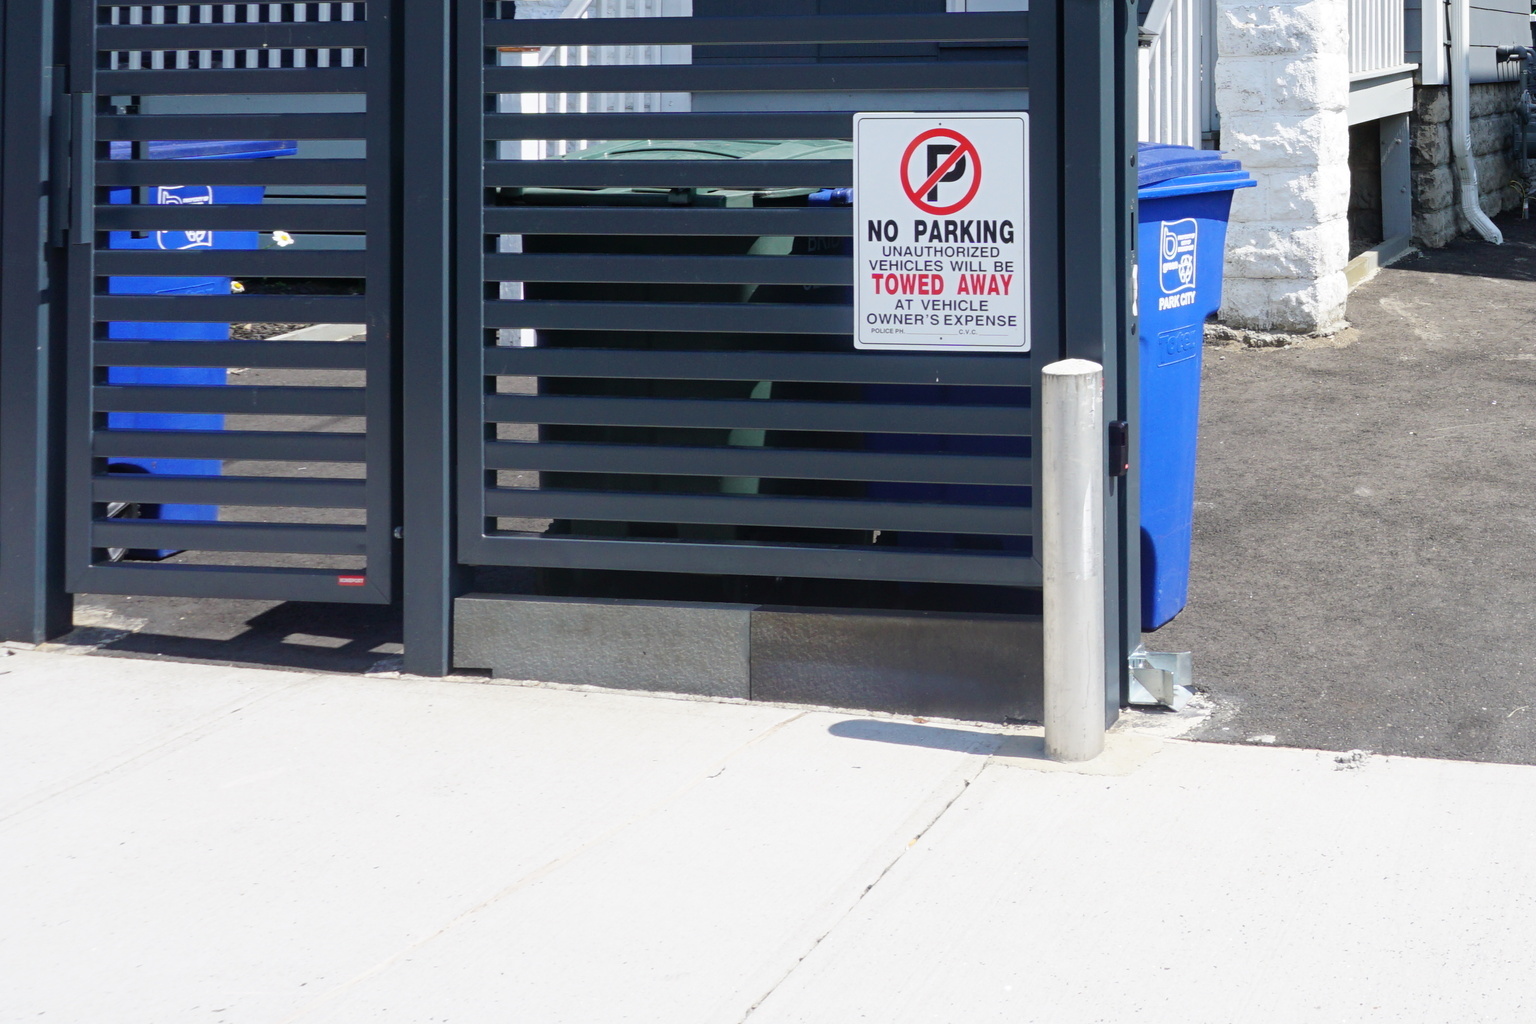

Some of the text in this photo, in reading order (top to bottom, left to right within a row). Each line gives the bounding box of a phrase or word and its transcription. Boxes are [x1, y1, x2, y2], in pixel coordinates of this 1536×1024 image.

[868, 219, 1015, 244] NO PARKING
[882, 245, 1000, 258] UNAUTHORIZED
[869, 259, 1014, 273] VEHICLES WILL BE
[871, 273, 1013, 296] TOWED AWAY
[895, 299, 989, 312] AT VEHICLE
[1158, 290, 1196, 311] PARK CITY
[866, 313, 1017, 327] OWNER'S EXPENSE
